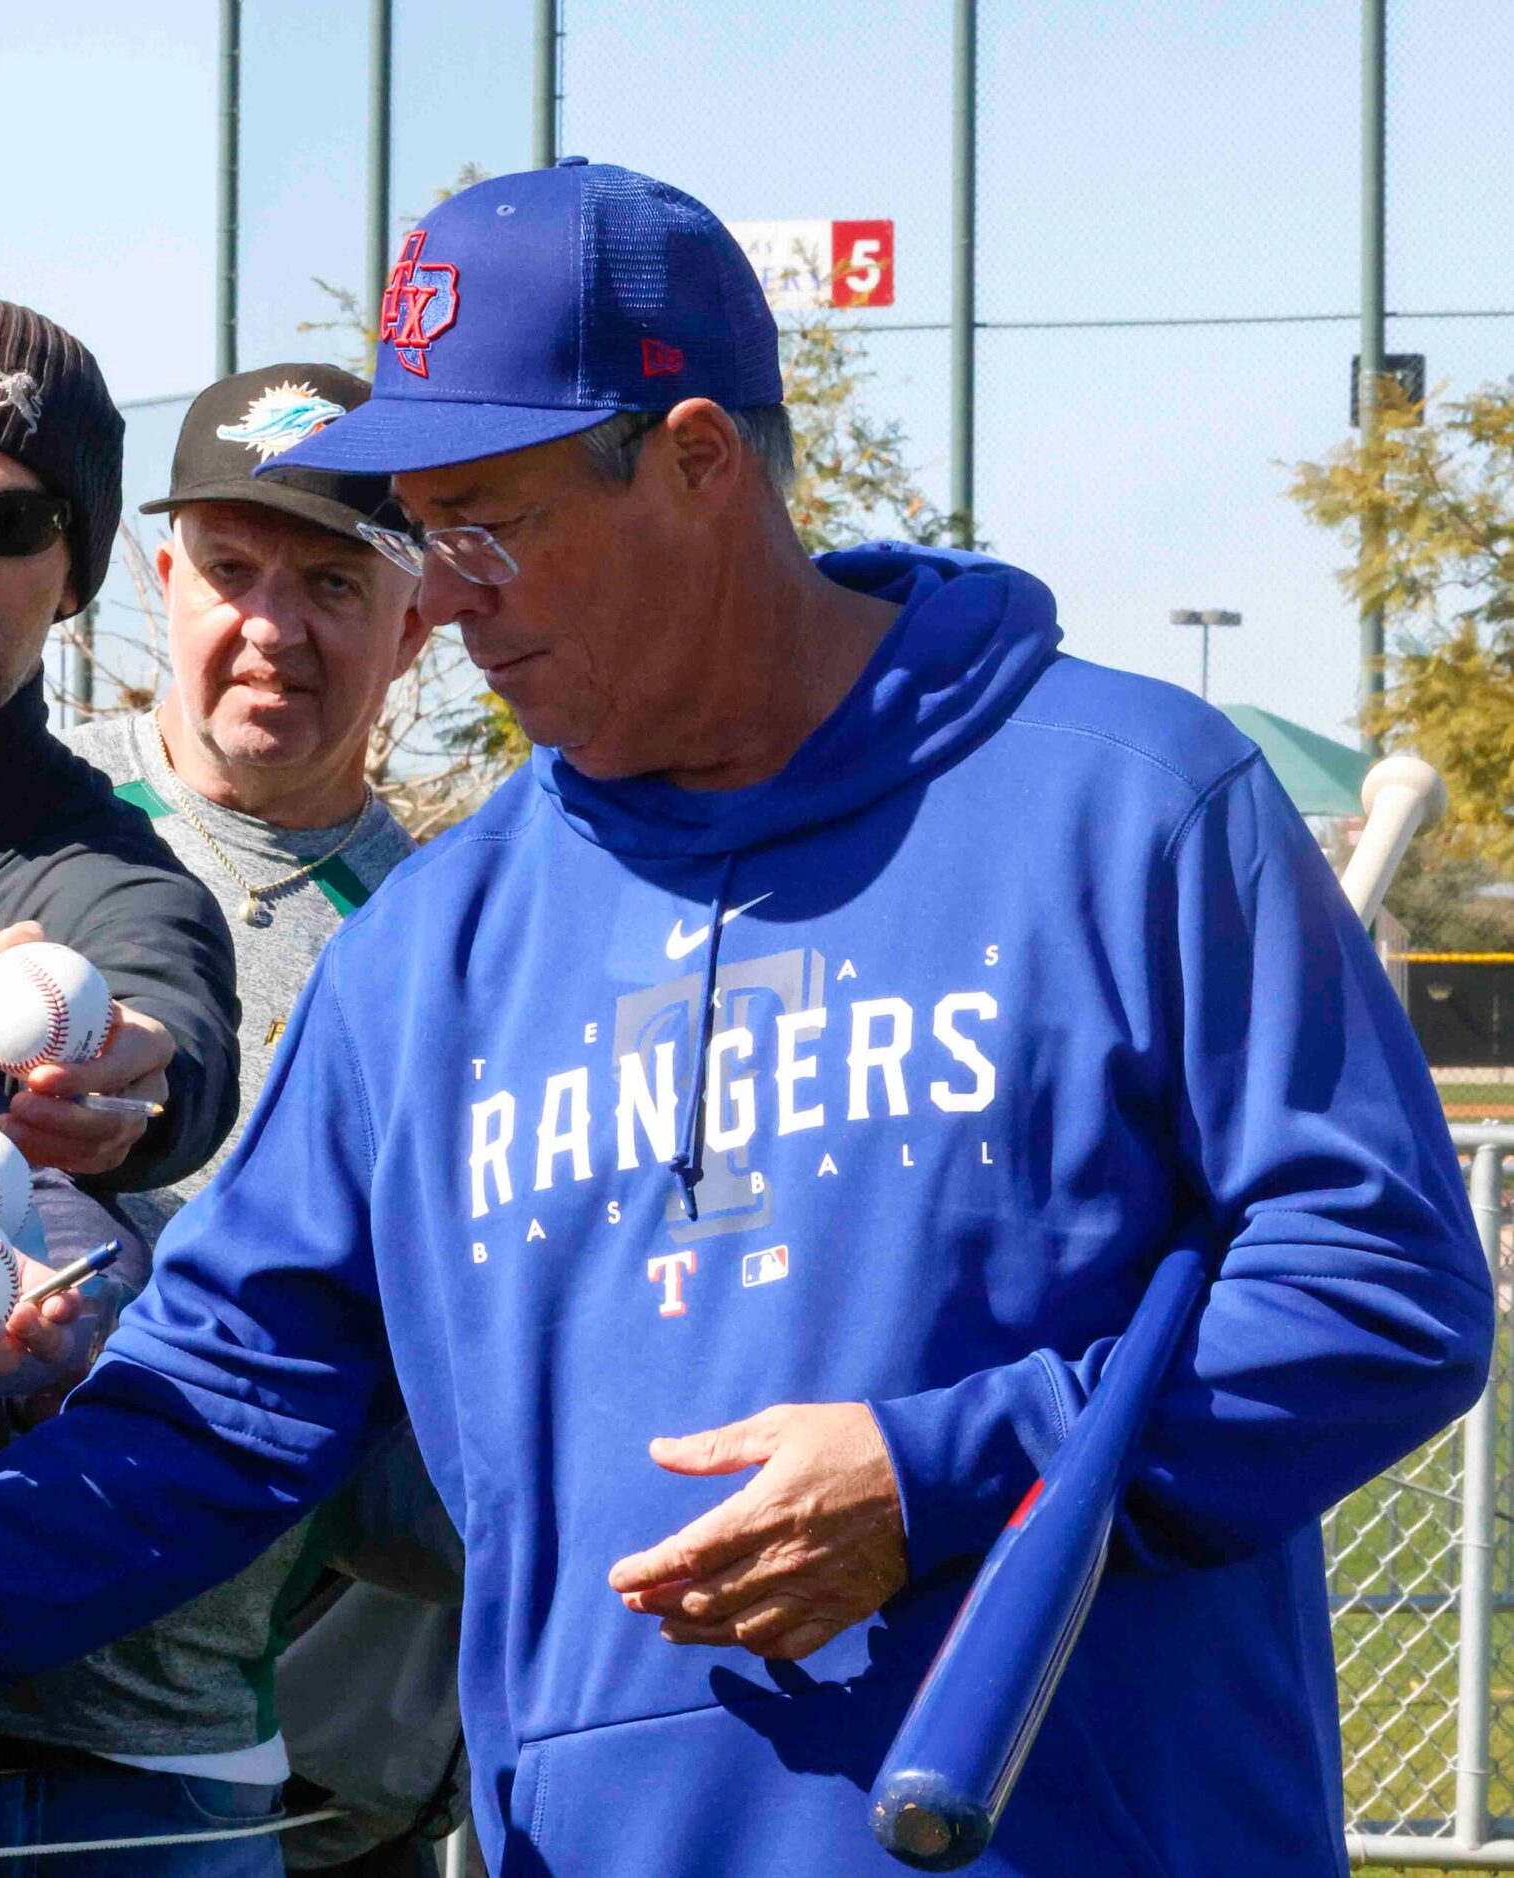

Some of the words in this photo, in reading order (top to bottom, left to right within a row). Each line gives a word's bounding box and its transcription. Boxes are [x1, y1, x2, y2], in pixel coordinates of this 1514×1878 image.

[846, 239, 881, 292] 5
[468, 990, 999, 1219] RANGERS
[472, 1141, 994, 1265] BASBALL
[647, 1250, 698, 1318] T
